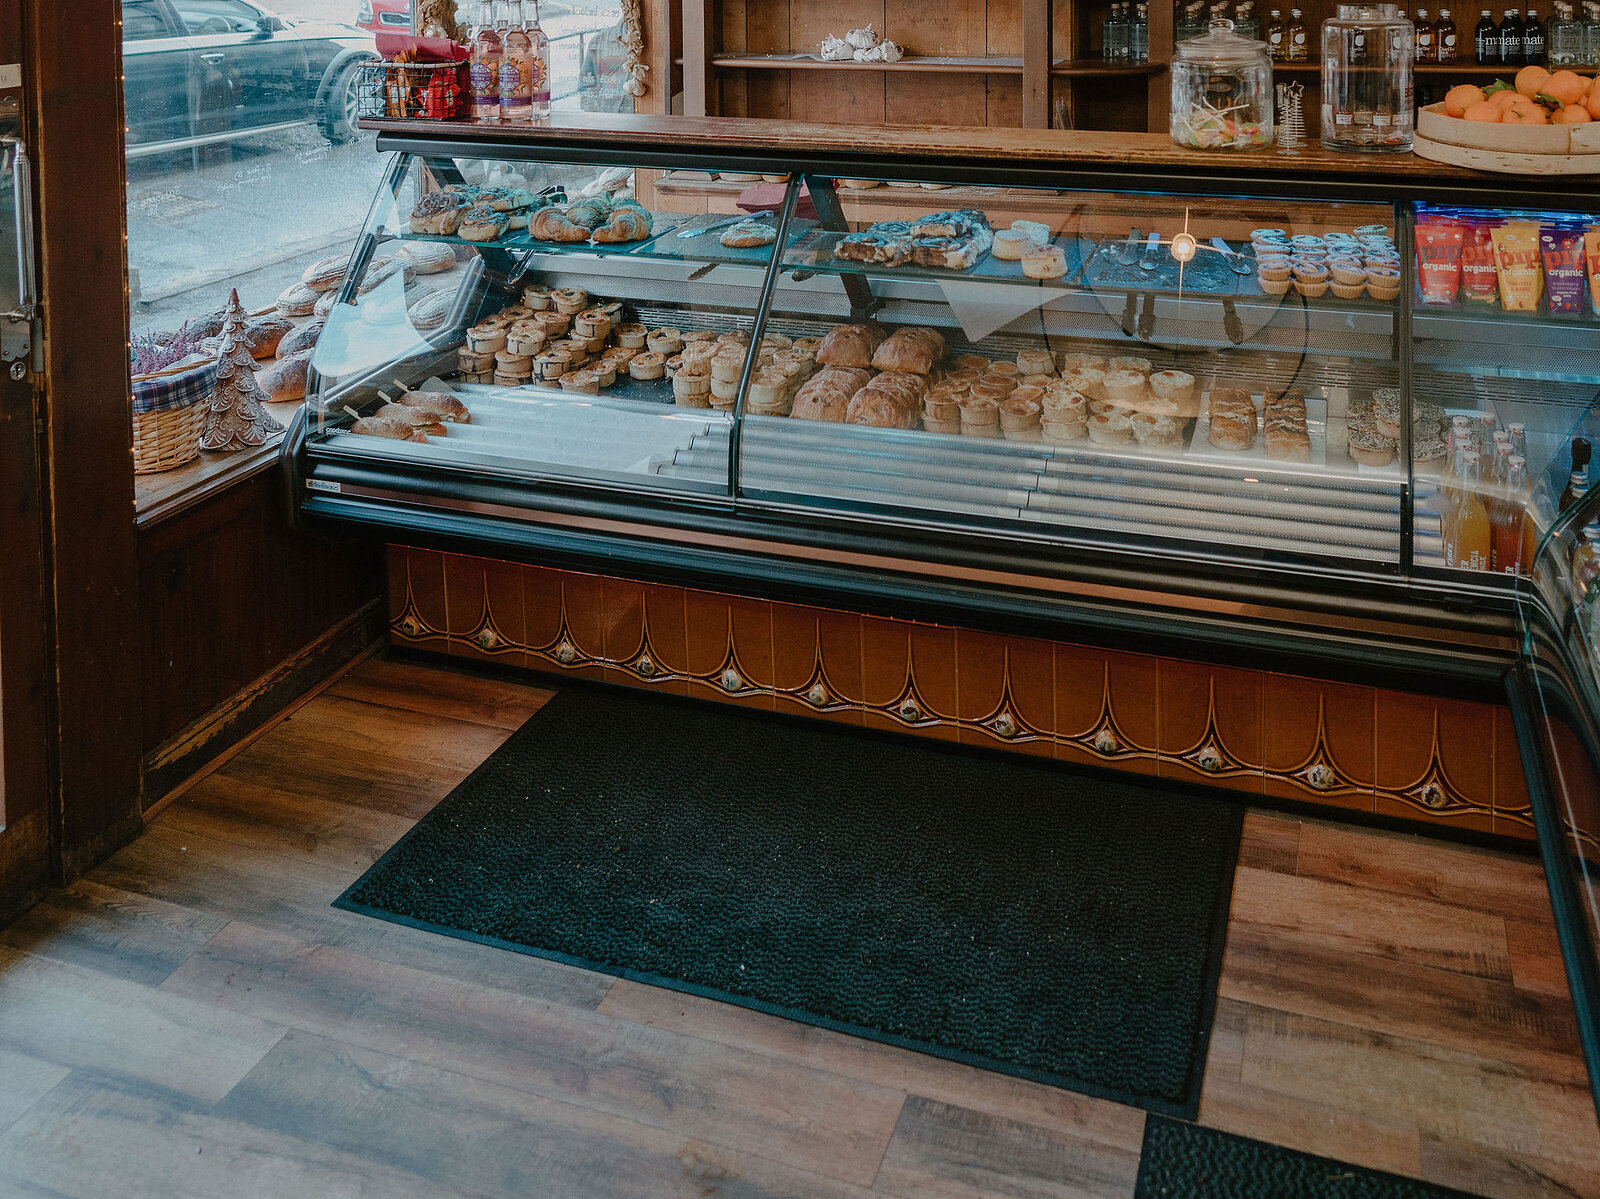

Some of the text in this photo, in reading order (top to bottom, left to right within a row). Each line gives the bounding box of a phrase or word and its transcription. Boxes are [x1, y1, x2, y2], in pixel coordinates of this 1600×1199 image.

[1522, 34, 1544, 45] mate
[1422, 263, 1457, 272] organic
[1463, 264, 1497, 273] organic
[1549, 269, 1584, 278] organic
[1461, 560, 1469, 570] ER
